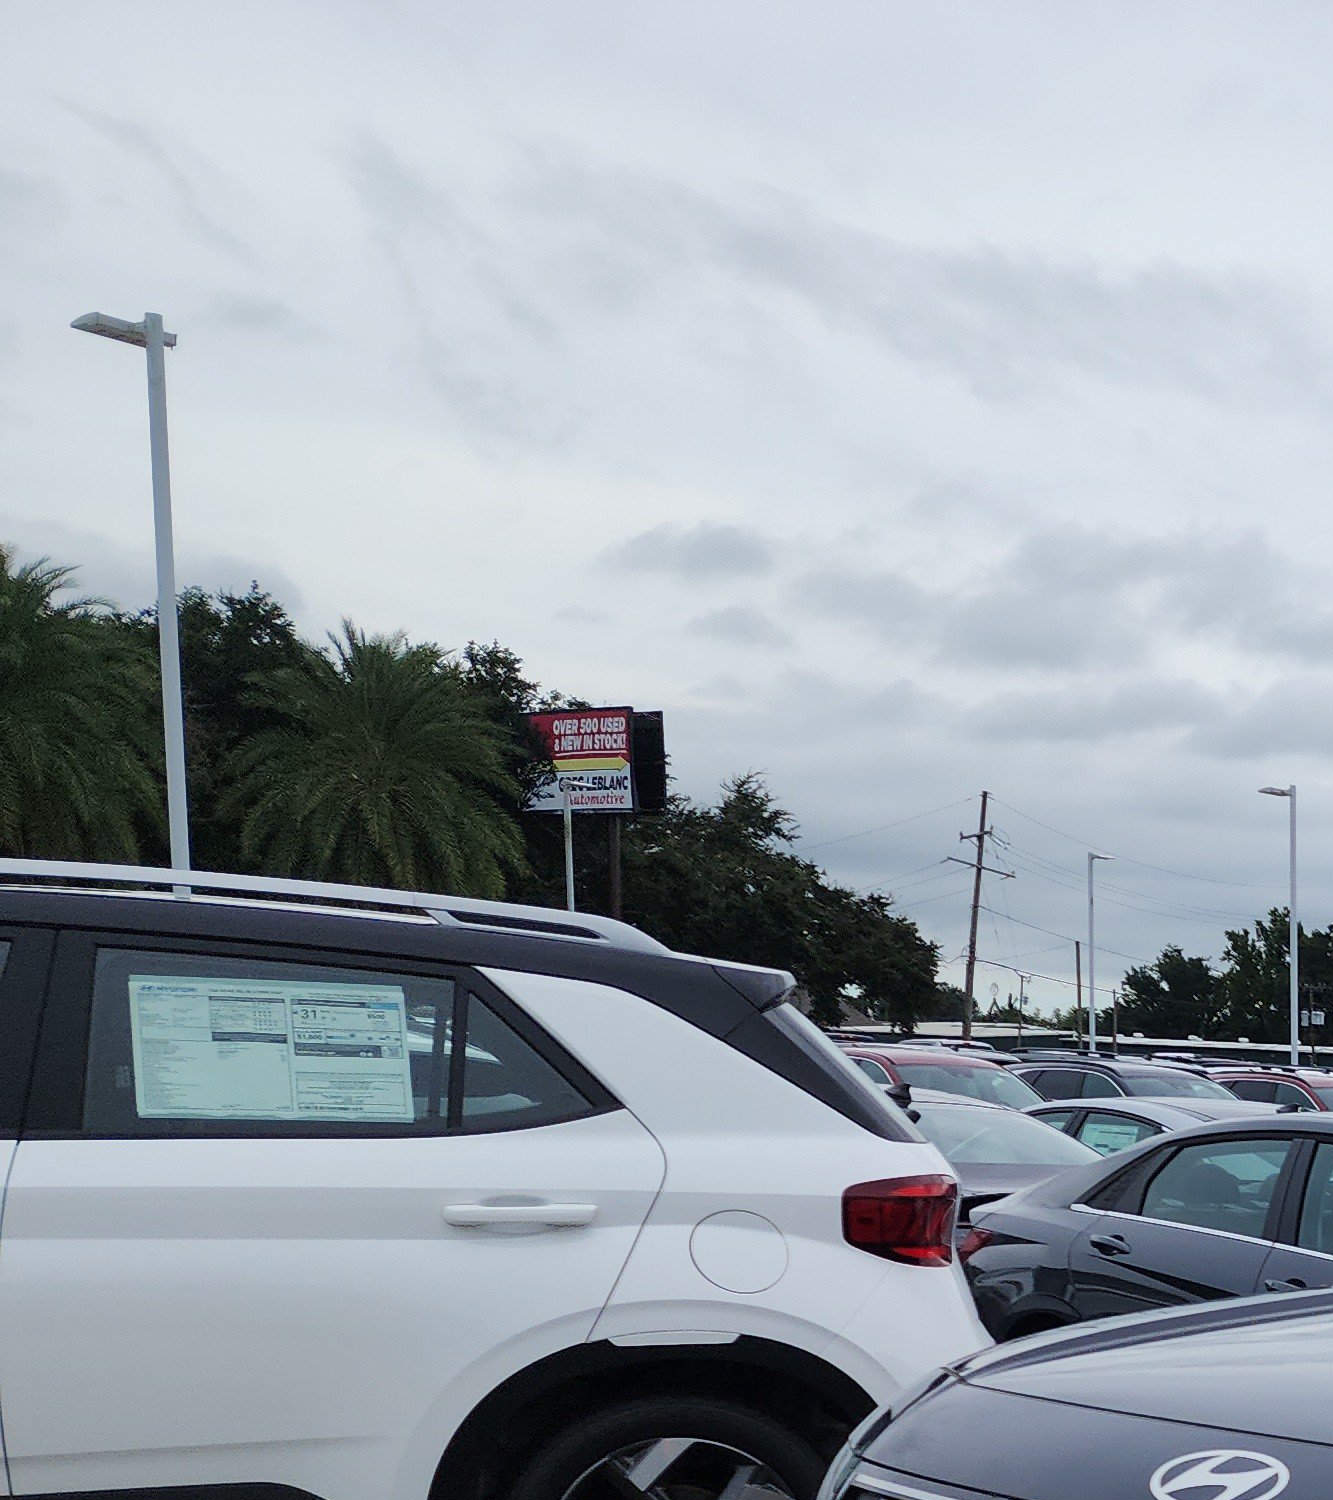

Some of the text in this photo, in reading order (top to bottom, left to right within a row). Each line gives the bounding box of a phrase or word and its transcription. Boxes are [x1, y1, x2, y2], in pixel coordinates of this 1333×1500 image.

[553, 717, 626, 735] OVER 500 USED
[554, 733, 627, 752] & NEW IN STOCK!
[300, 1008, 317, 1020] 31
